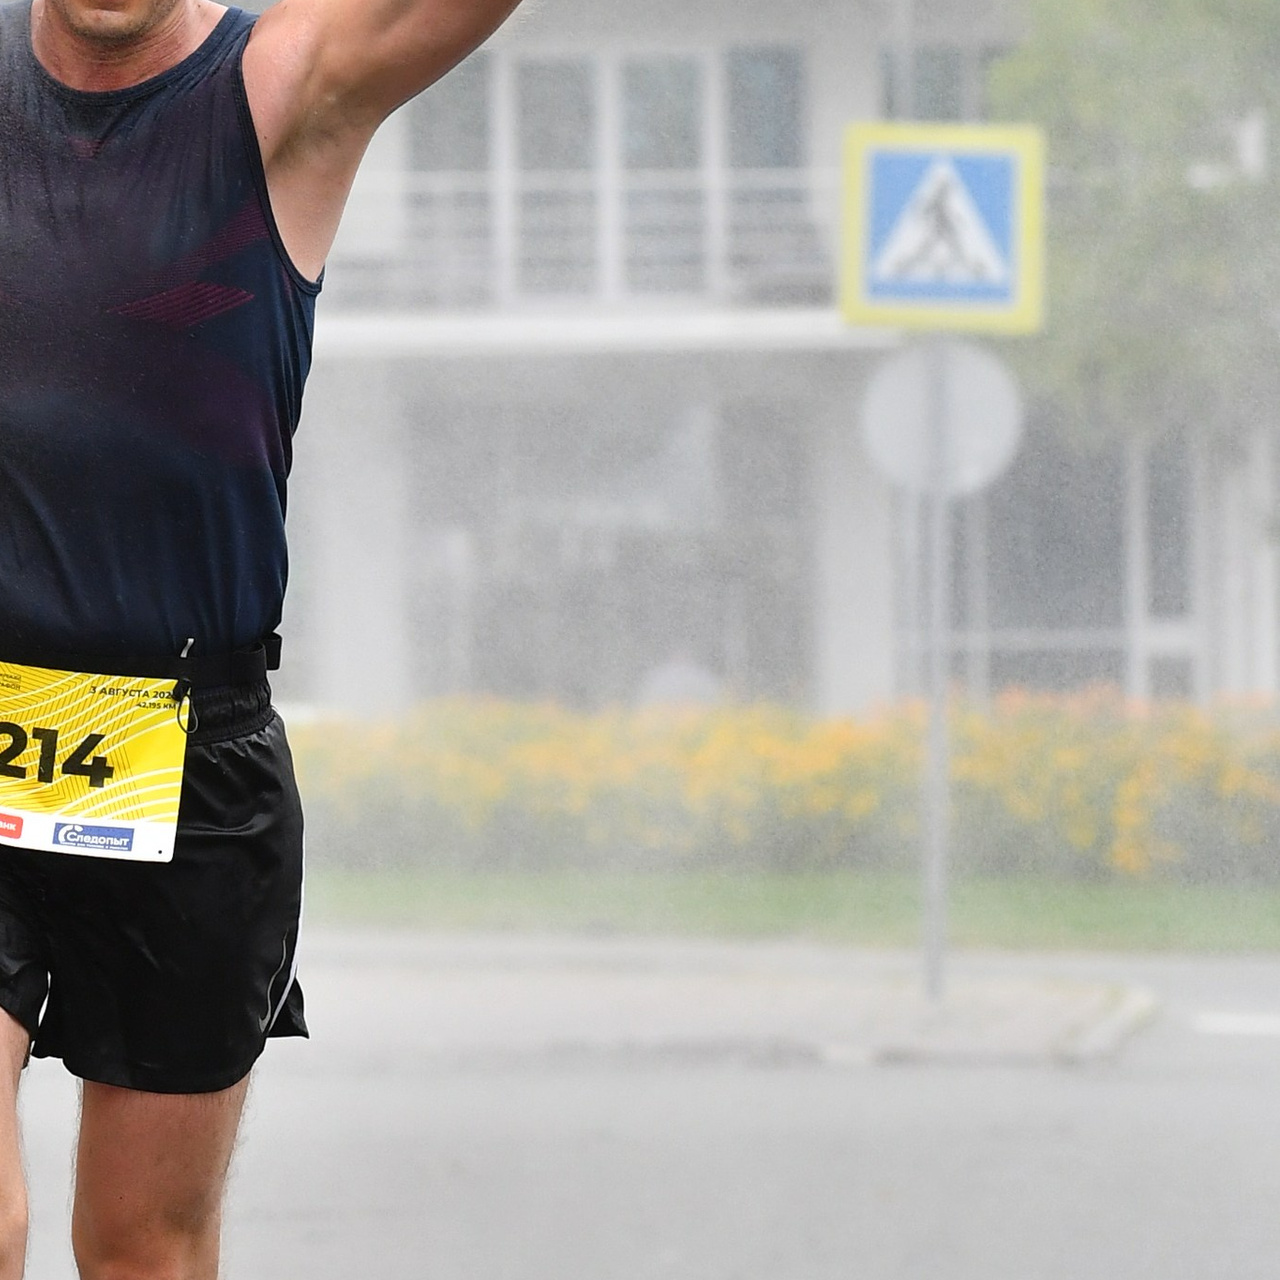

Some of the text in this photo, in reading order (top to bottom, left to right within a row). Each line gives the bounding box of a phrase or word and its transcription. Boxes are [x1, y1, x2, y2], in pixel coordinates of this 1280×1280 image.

[89, 685, 174, 700] 3 АВГУСТА 202
[66, 830, 130, 847] Следопыт
